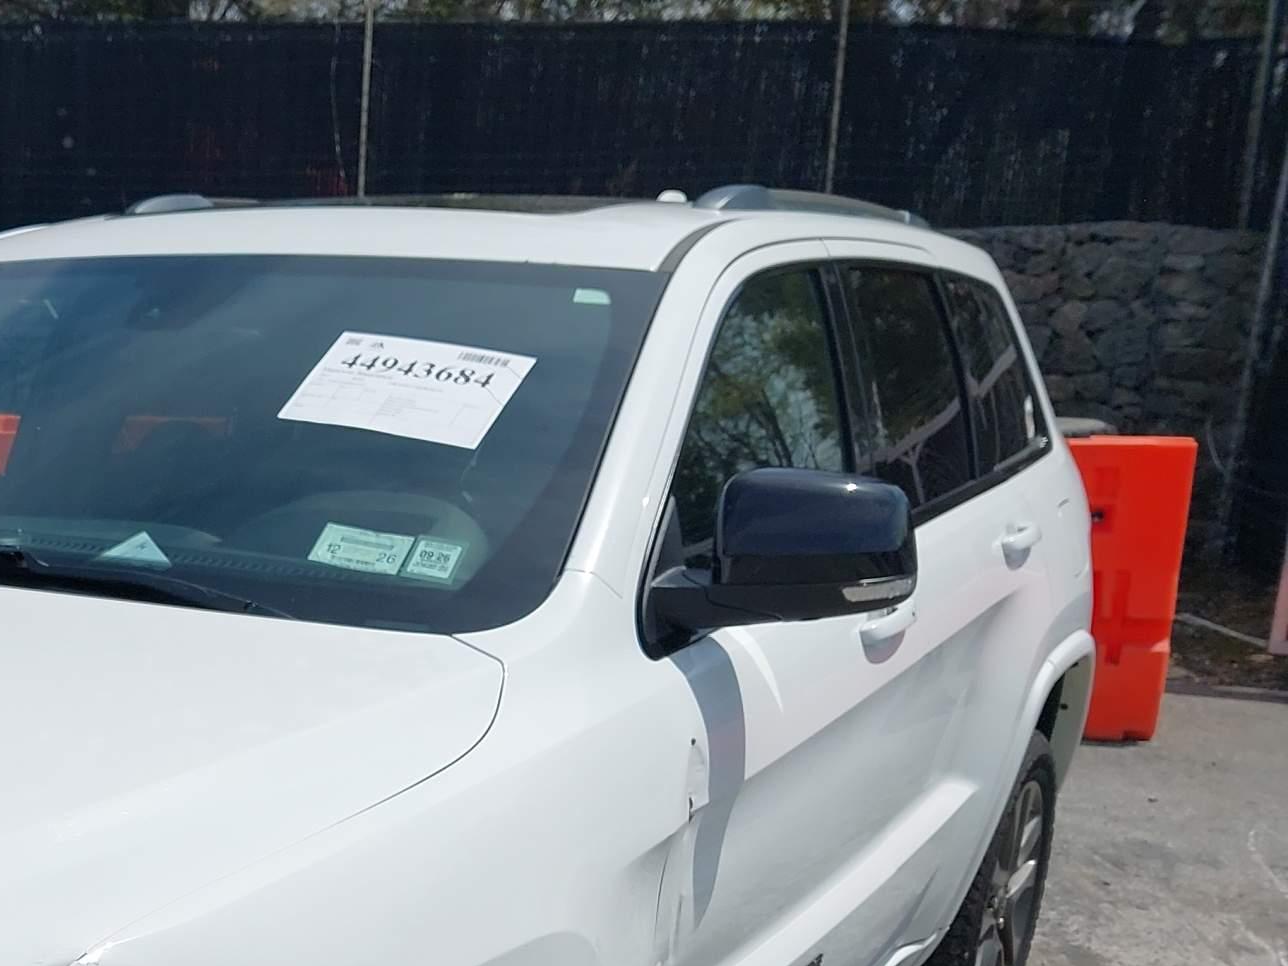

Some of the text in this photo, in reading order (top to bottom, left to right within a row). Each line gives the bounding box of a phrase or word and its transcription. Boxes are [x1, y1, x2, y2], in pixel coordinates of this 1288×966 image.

[341, 353, 495, 389] 44943684
[327, 543, 342, 554] 12
[375, 553, 397, 565] 26
